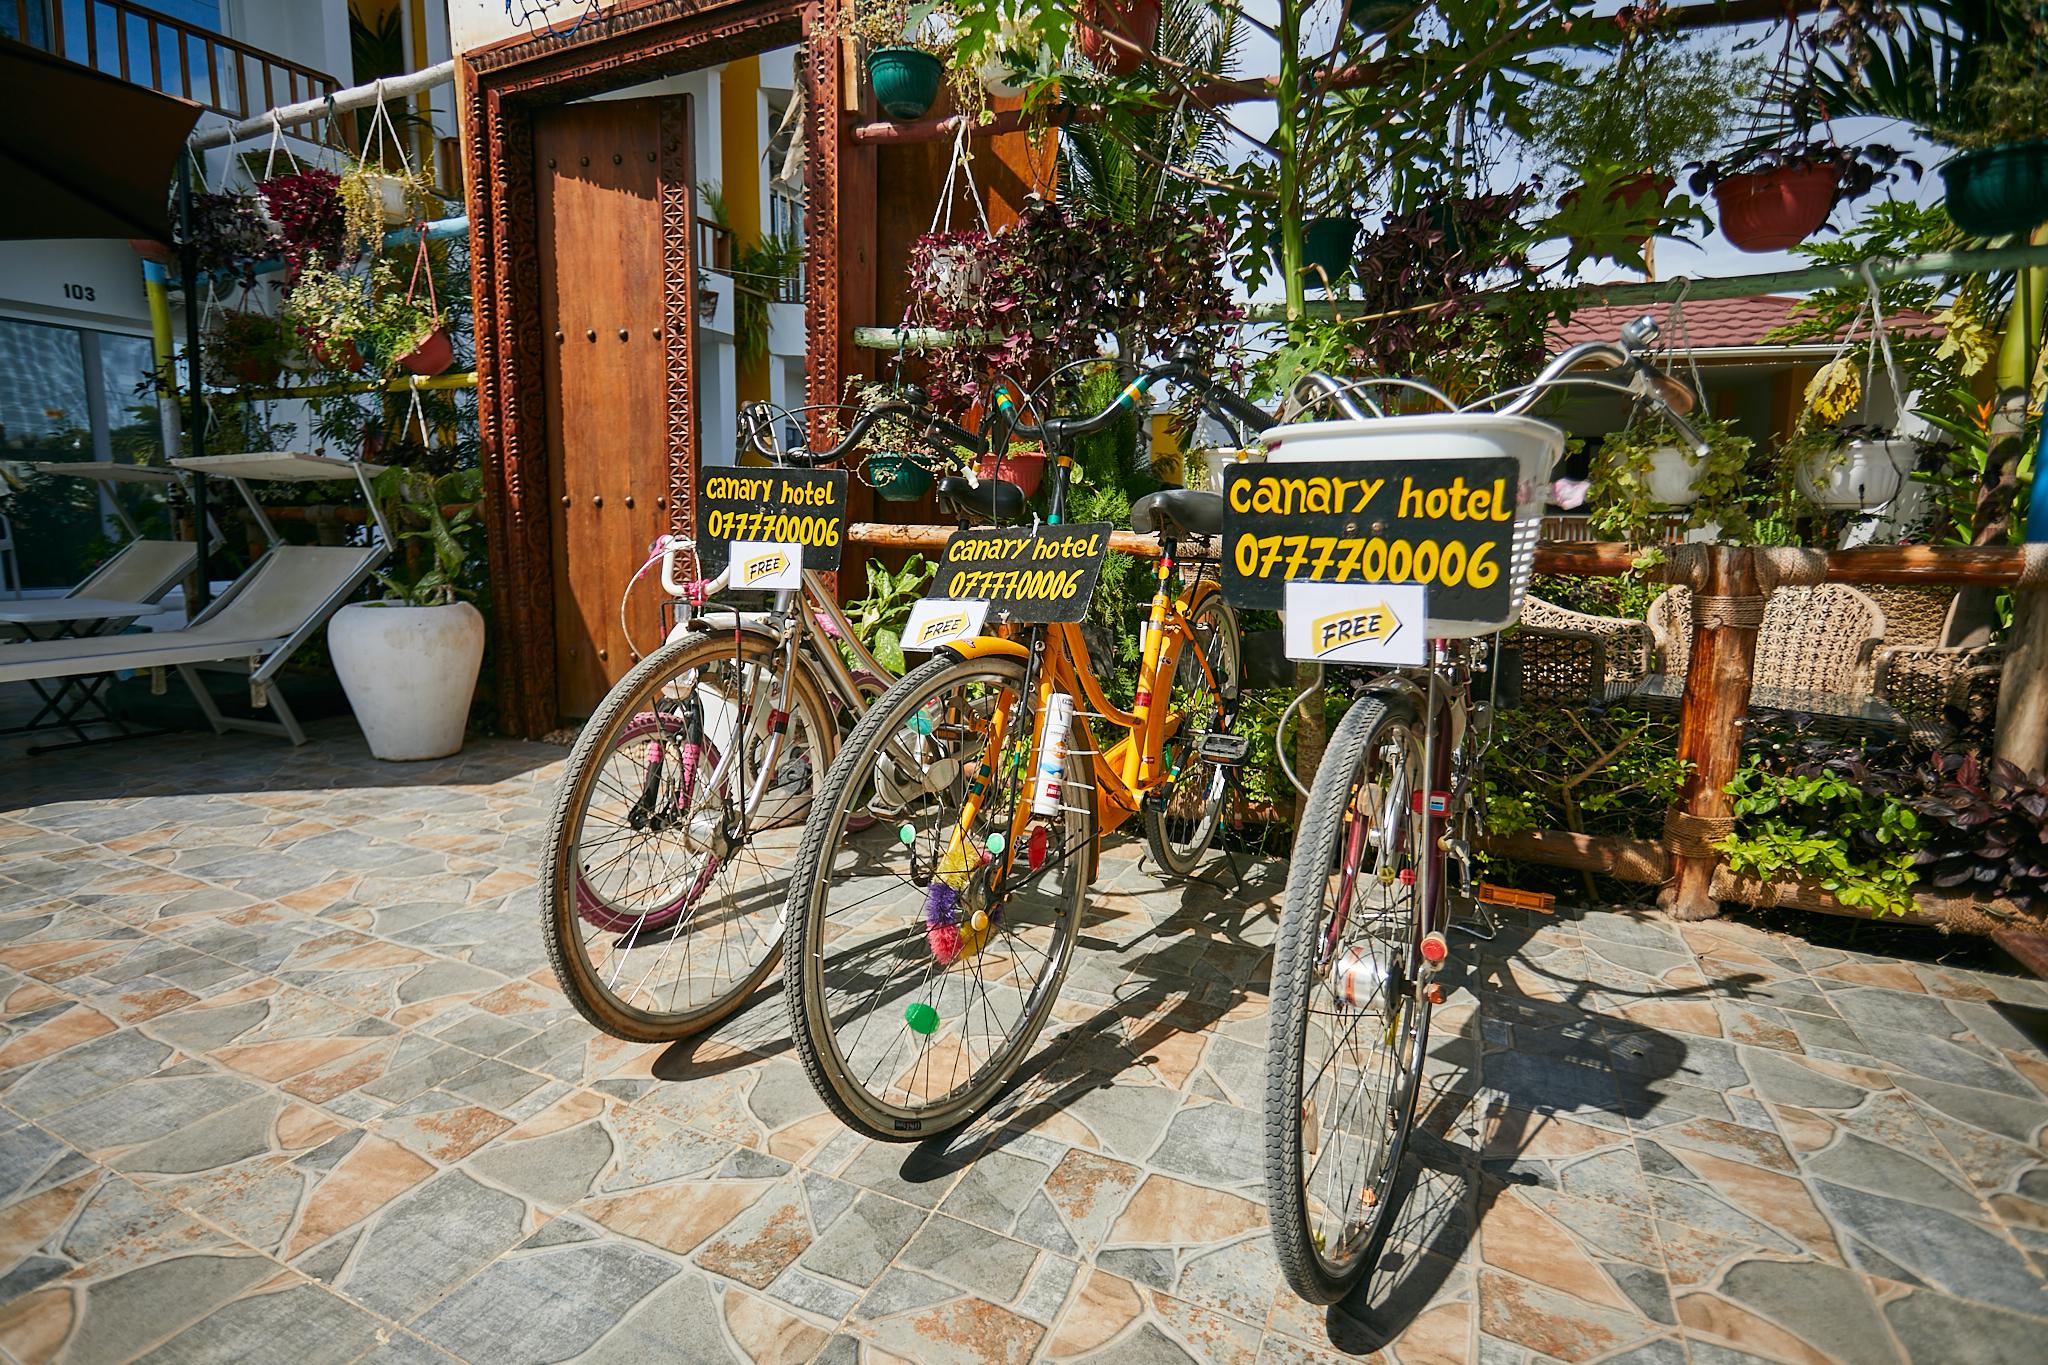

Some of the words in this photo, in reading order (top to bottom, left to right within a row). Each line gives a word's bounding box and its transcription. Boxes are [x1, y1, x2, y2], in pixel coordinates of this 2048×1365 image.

[63, 283, 96, 302] 103
[705, 477, 773, 503] canary
[780, 480, 835, 507] hotel
[1229, 476, 1386, 515] canary
[1397, 476, 1513, 522] hotel
[708, 510, 840, 547] 0777700006
[948, 538, 1031, 562] canary
[1031, 533, 1100, 561] hotel
[1234, 533, 1500, 590] 0777700006
[749, 557, 781, 580] FREE
[948, 568, 1085, 601] 0777700006
[923, 618, 962, 640] FREE
[1321, 614, 1383, 648] FREE
